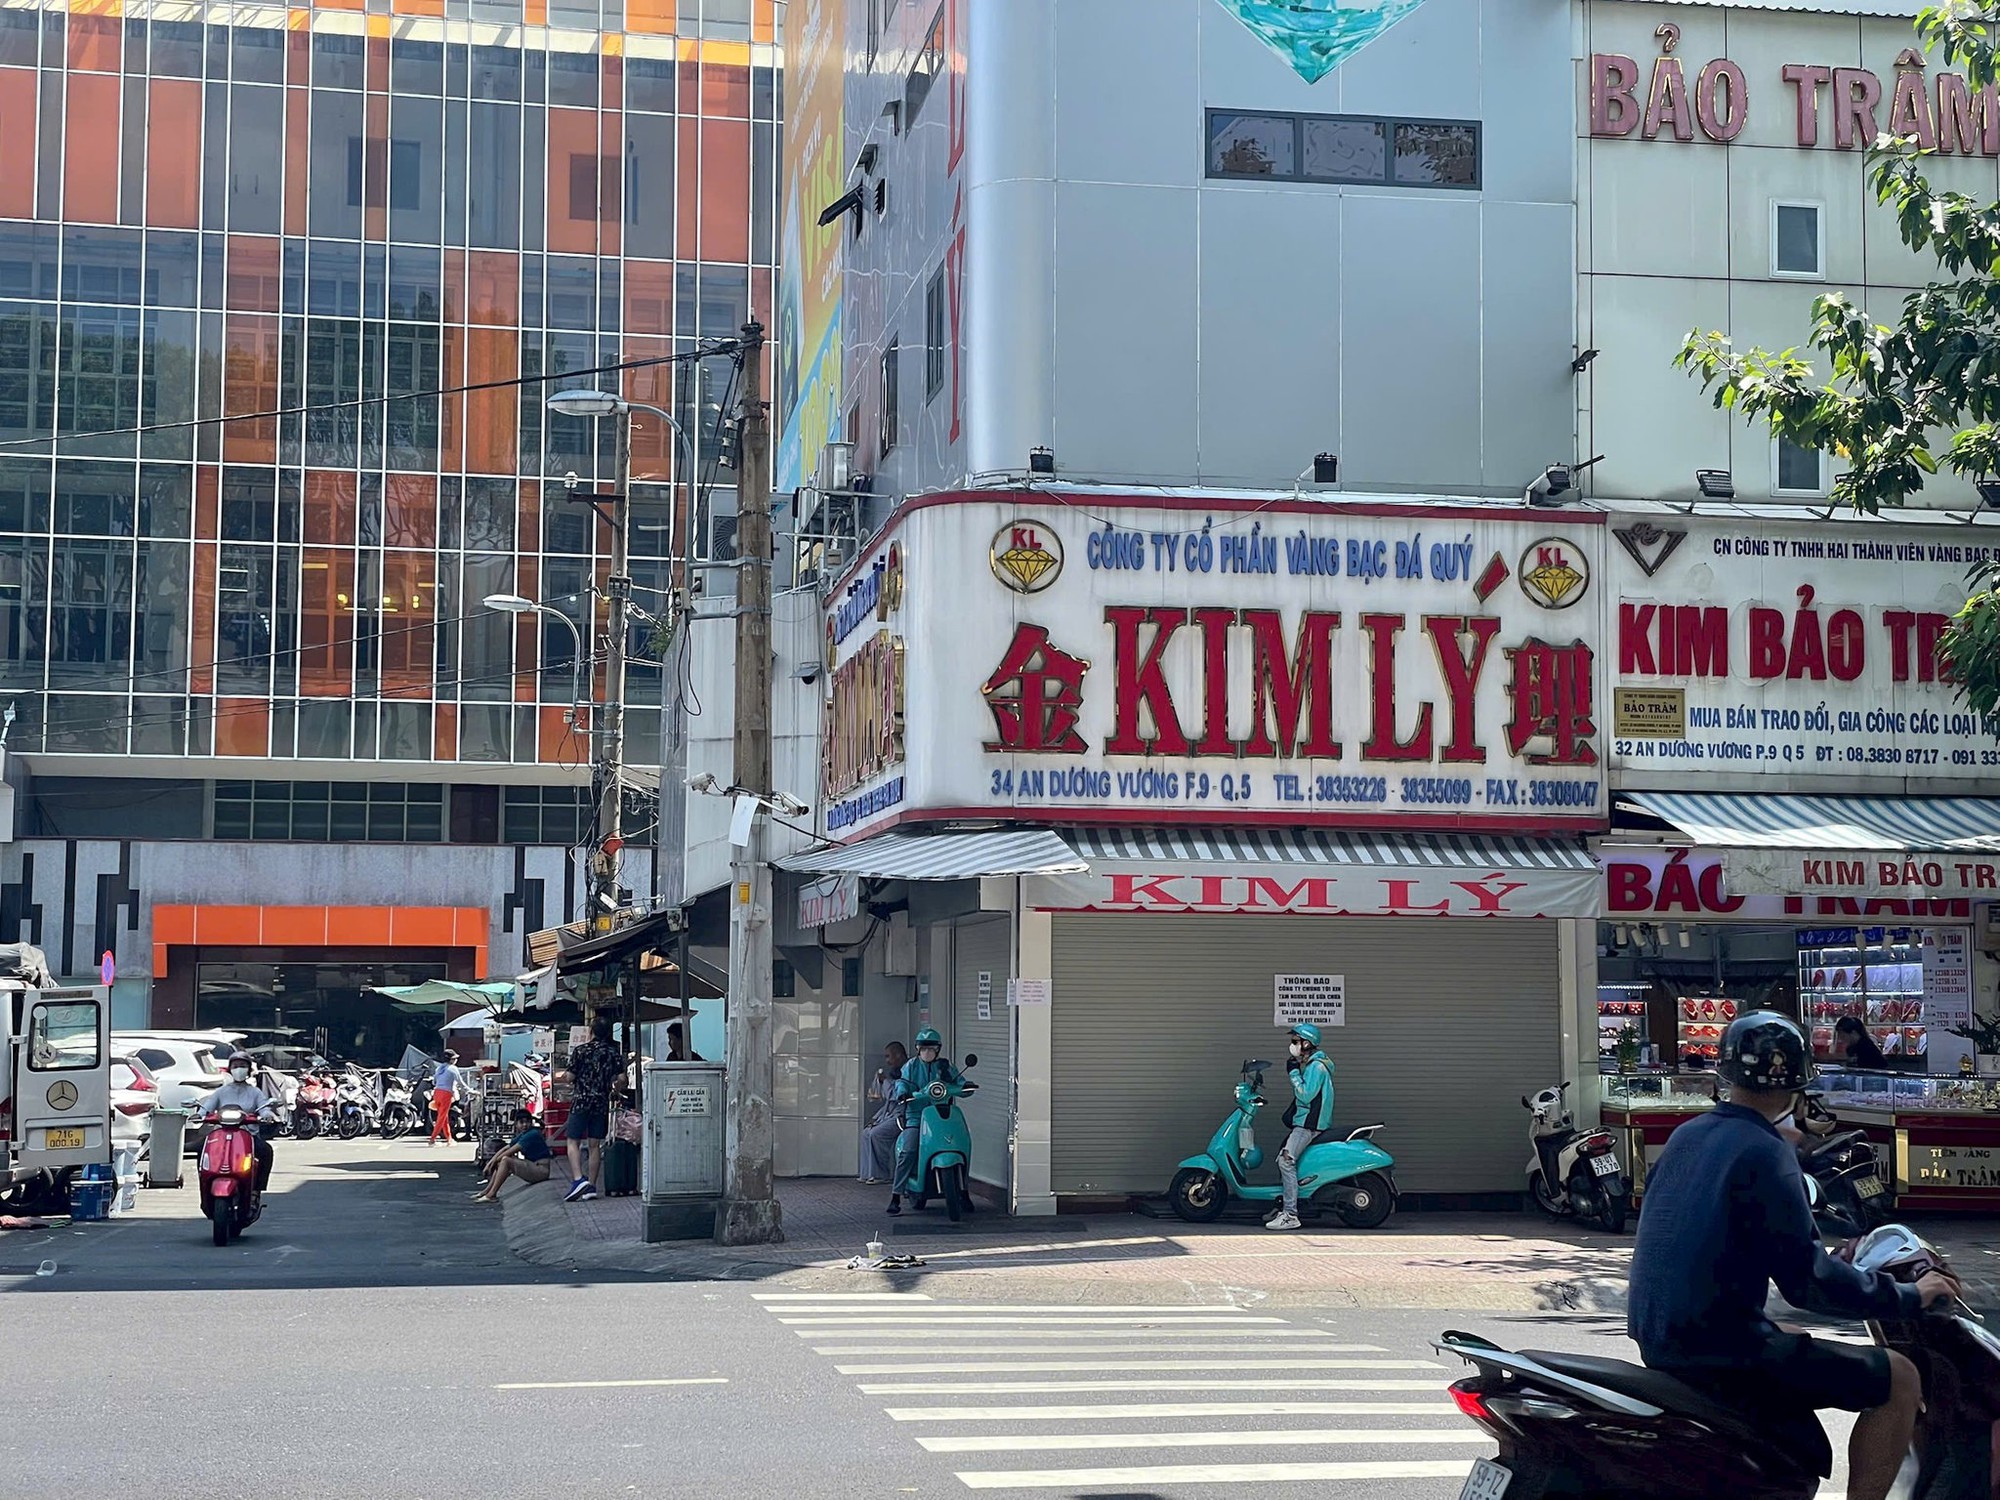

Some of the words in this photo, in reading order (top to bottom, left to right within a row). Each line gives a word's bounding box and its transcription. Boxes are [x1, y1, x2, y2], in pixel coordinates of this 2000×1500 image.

[1590, 22, 1749, 143] BẢO
[1782, 47, 2000, 155] TRÂM
[1010, 528, 1042, 550] KL
[1086, 520, 1145, 571] CÔNG
[1151, 532, 1180, 572] TY
[1184, 515, 1214, 573] CỔ
[1220, 521, 1277, 574] PHẦN
[1285, 529, 1340, 576] VÀNG
[1346, 539, 1387, 585] BẠC
[1395, 532, 1423, 580] ĐÁ
[1430, 533, 1474, 581] QUÝ
[1713, 537, 1731, 555] CN
[1735, 535, 1770, 557] CÔNG
[1773, 541, 1788, 557] TY
[1791, 541, 1824, 559] TNHH
[1827, 542, 1849, 559] HAI
[1852, 539, 1893, 560] THÀNH
[1896, 541, 1925, 561] VIÊN
[1928, 542, 1962, 563] VÀNG
[1537, 547, 1568, 567] KL
[1619, 603, 1729, 676] KIM
[1749, 583, 1865, 681] BẢO
[980, 621, 1092, 754] 金
[1102, 604, 1343, 760] KIM
[1624, 700, 1645, 713] BẢO
[1648, 701, 1677, 713] TRÂM
[1689, 706, 1722, 728] MUA
[1726, 703, 1757, 729] BÁN
[1761, 708, 1799, 731] TRAO
[1838, 709, 1861, 733] GIA
[1866, 707, 1906, 733] CÔNG
[1910, 708, 1940, 735] CÁC
[1944, 713, 1977, 739] LOẠI
[1615, 740, 1632, 756] 32
[1636, 741, 1654, 757] AN
[1659, 739, 1704, 758] DƯƠNG
[1708, 740, 1752, 760] VƯƠNG
[1905, 748, 1939, 765] 8717
[1952, 749, 1977, 765] 091
[991, 768, 1014, 797] 34
[1018, 770, 1044, 798] AN
[1050, 765, 1112, 798] DƯƠNG
[1117, 766, 1179, 800] VƯƠNG
[1803, 859, 1866, 886] KIM
[1879, 854, 1944, 888] BẢO
[1102, 873, 1338, 909] KIM
[1378, 872, 1529, 912] LÝ
[801, 897, 824, 925] KIM
[57, 1130, 73, 1139] 71G
